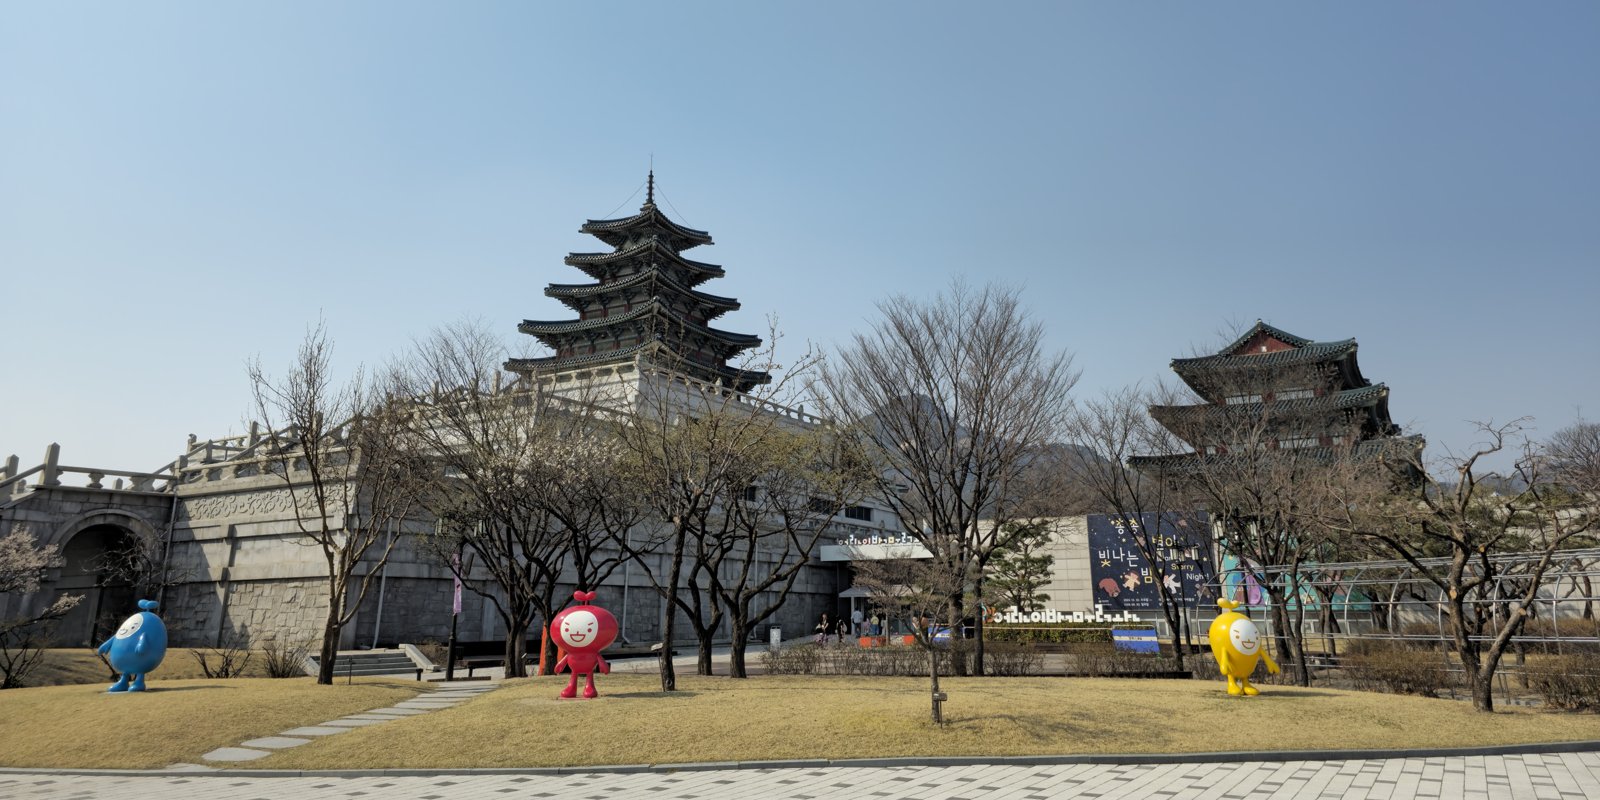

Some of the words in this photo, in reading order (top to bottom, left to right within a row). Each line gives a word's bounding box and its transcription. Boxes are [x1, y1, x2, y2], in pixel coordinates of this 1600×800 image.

[1098, 547, 1139, 567] 빛나는
[1141, 567, 1153, 584] 밤
[993, 604, 1141, 623] 어린이박물관
